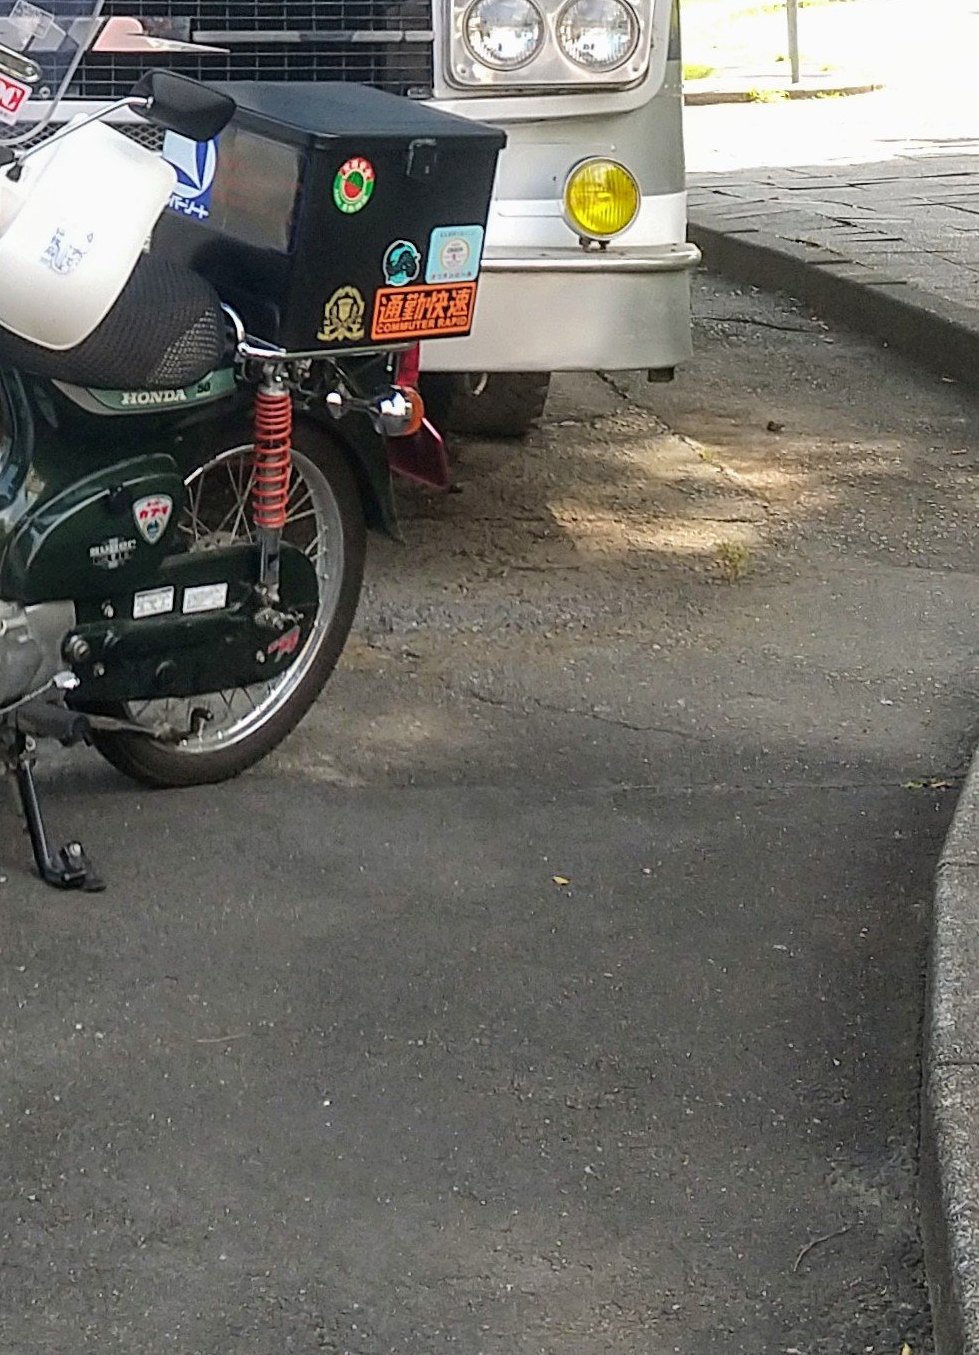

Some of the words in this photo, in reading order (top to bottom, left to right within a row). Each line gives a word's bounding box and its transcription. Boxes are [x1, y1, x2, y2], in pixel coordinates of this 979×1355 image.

[379, 289, 470, 323] 通勤快速
[377, 320, 436, 334] COMMUTER
[437, 316, 468, 328] RAPID
[121, 389, 187, 405] HONDA
